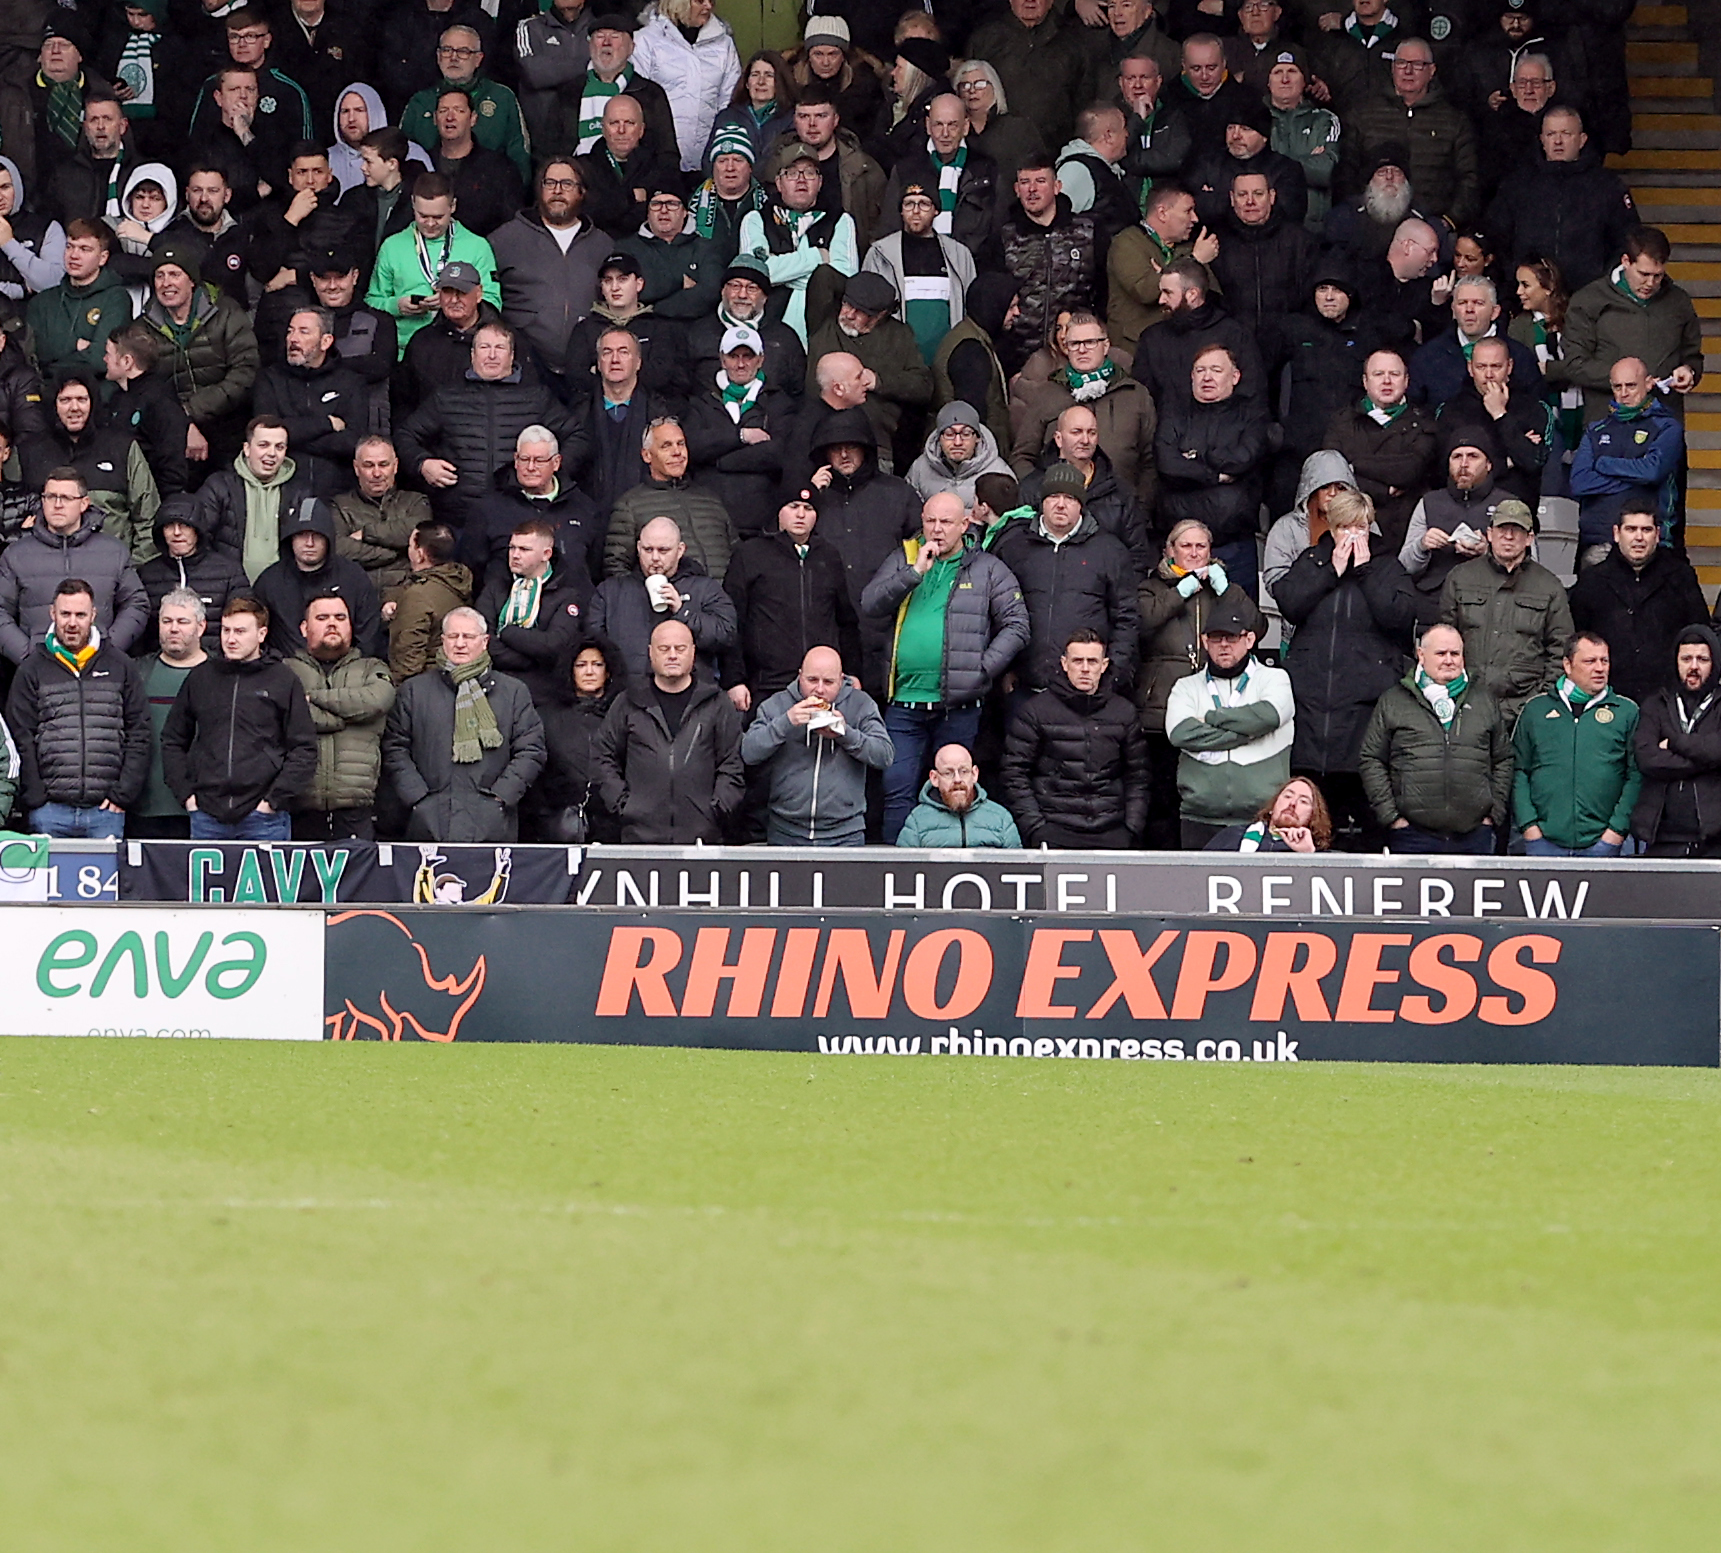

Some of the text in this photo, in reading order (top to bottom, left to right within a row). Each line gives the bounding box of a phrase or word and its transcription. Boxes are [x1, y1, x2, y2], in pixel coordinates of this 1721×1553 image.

[189, 848, 350, 904] CAVY
[1209, 875, 1590, 919] RENFREW
[36, 929, 268, 999] enva
[595, 926, 1563, 1026] RHINO EXPRESS
